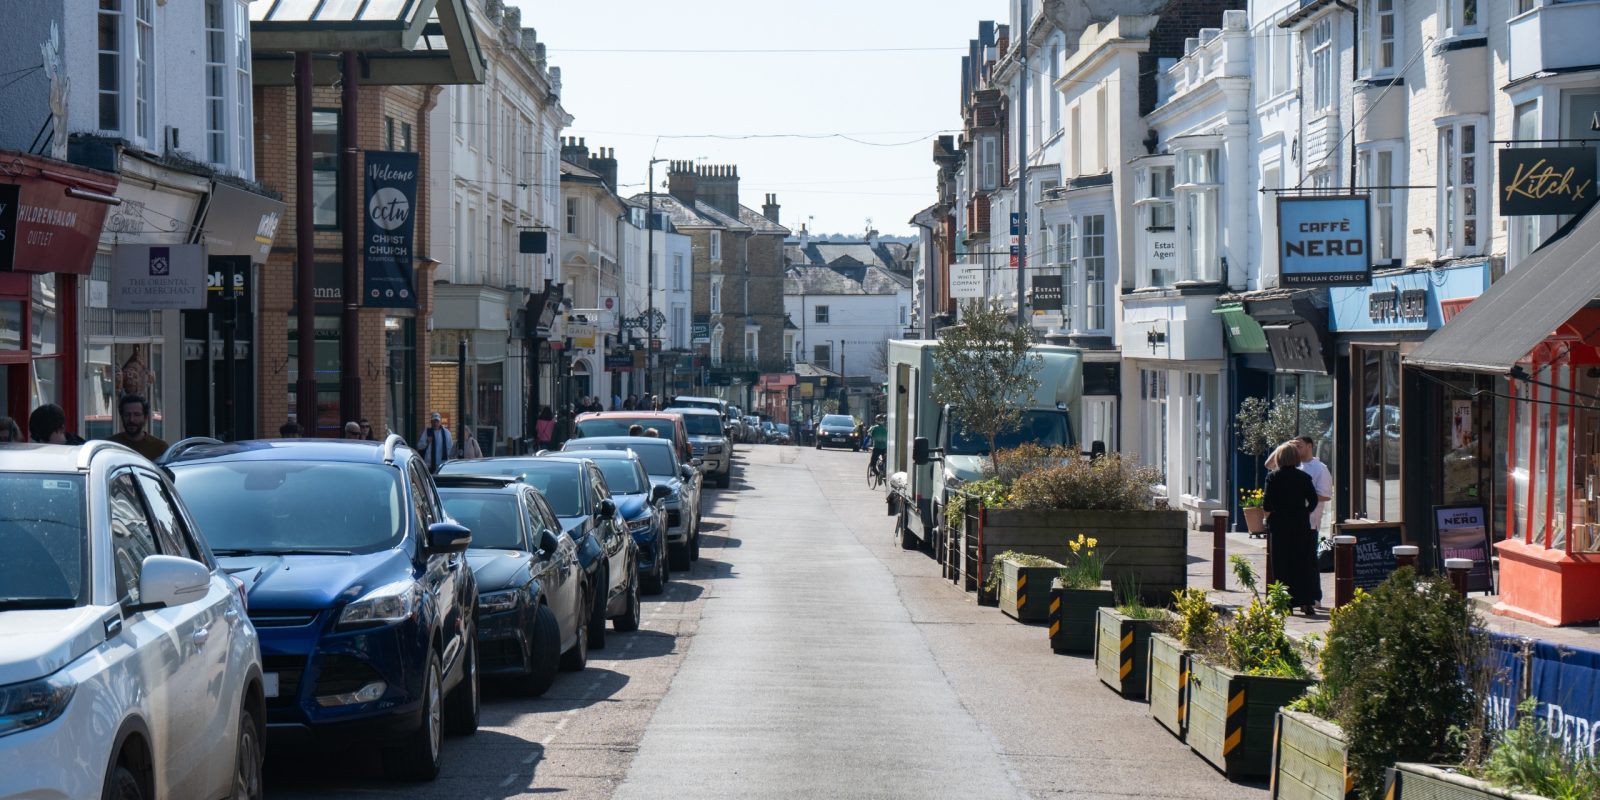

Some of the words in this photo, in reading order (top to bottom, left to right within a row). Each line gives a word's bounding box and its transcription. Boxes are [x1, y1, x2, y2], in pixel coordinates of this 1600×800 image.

[368, 163, 414, 181] Welcome
[1505, 159, 1575, 201] Kitch
[18, 205, 78, 227] HILDRENSALON
[371, 197, 410, 222] cctw
[27, 230, 54, 246] OUTLET
[1154, 241, 1175, 249] Estat
[1285, 239, 1363, 257] NERO
[144, 287, 197, 295] MERCHANT
[1454, 406, 1470, 416] LATTE
[1444, 516, 1478, 526] NERO
[1356, 542, 1380, 554] KATE
